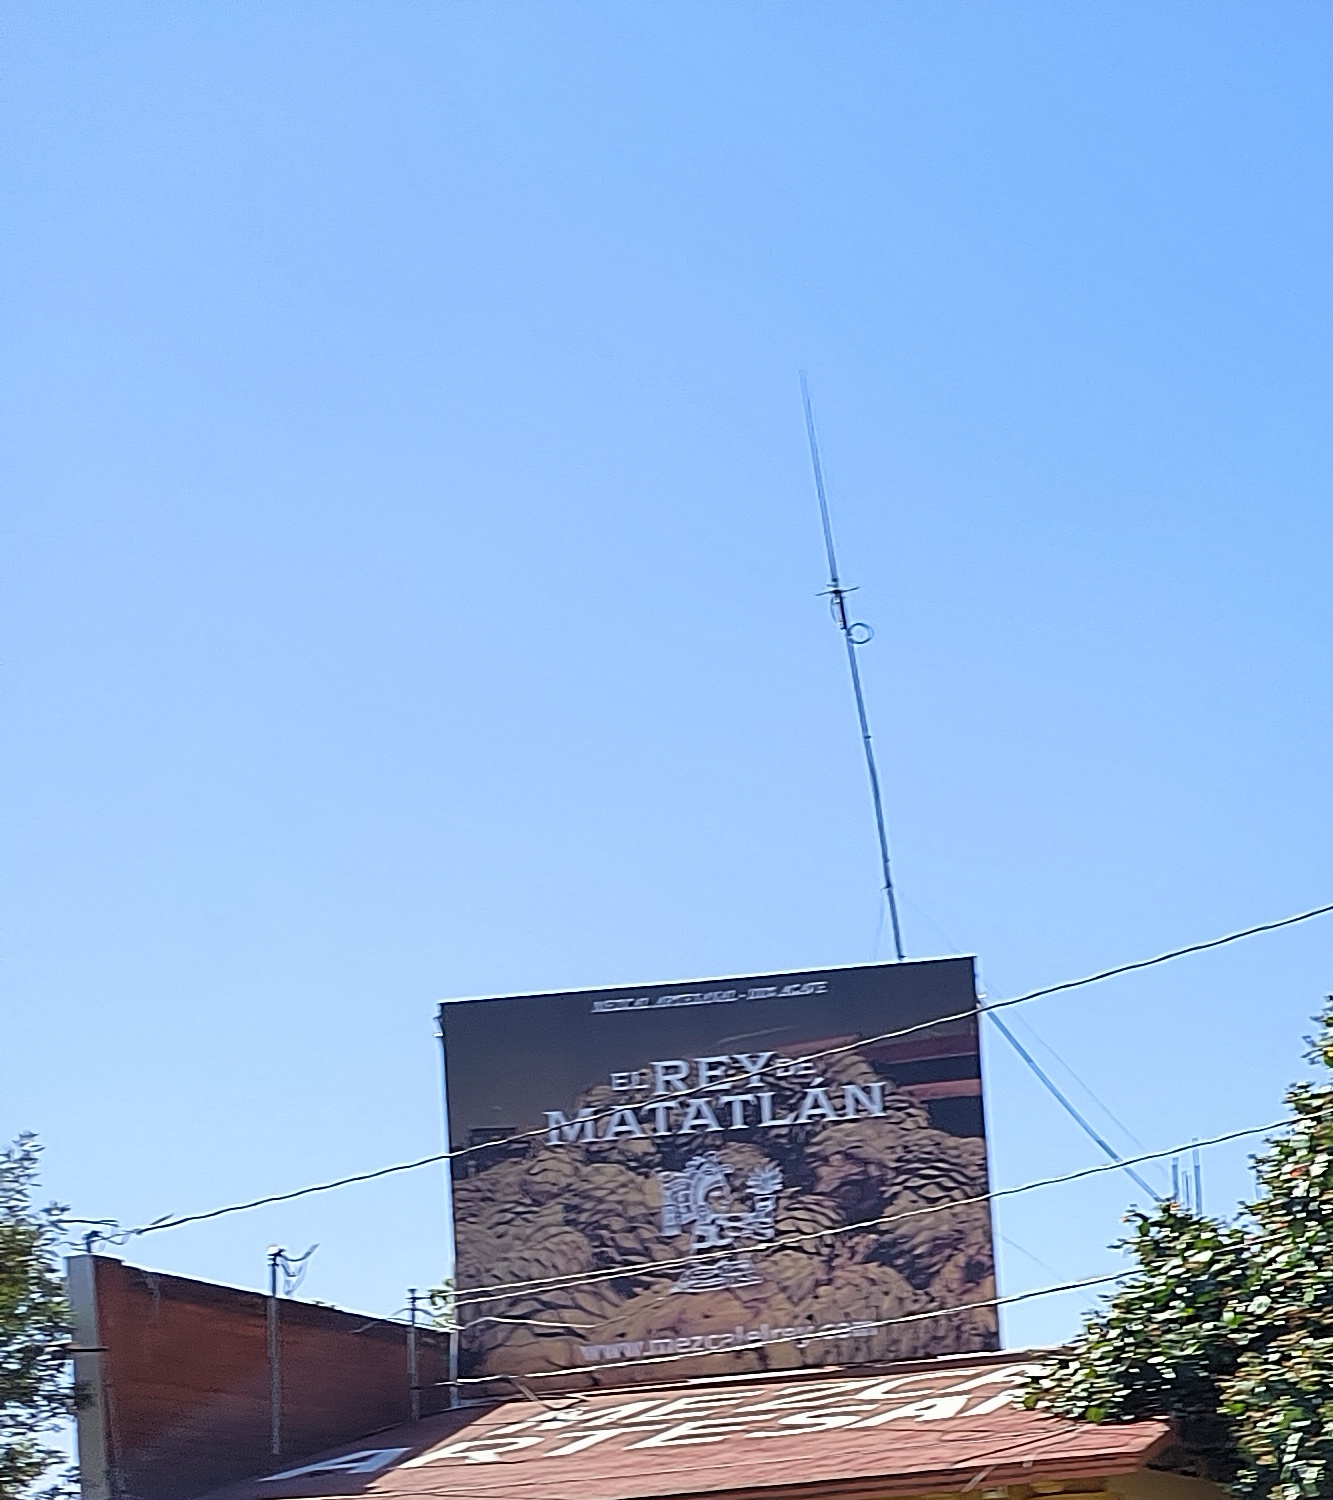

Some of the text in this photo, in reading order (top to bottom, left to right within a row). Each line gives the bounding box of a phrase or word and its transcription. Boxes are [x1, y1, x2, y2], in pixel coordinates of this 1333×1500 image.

[610, 1051, 816, 1097] EL REY DE
[543, 1077, 888, 1147] MATATLÁN
